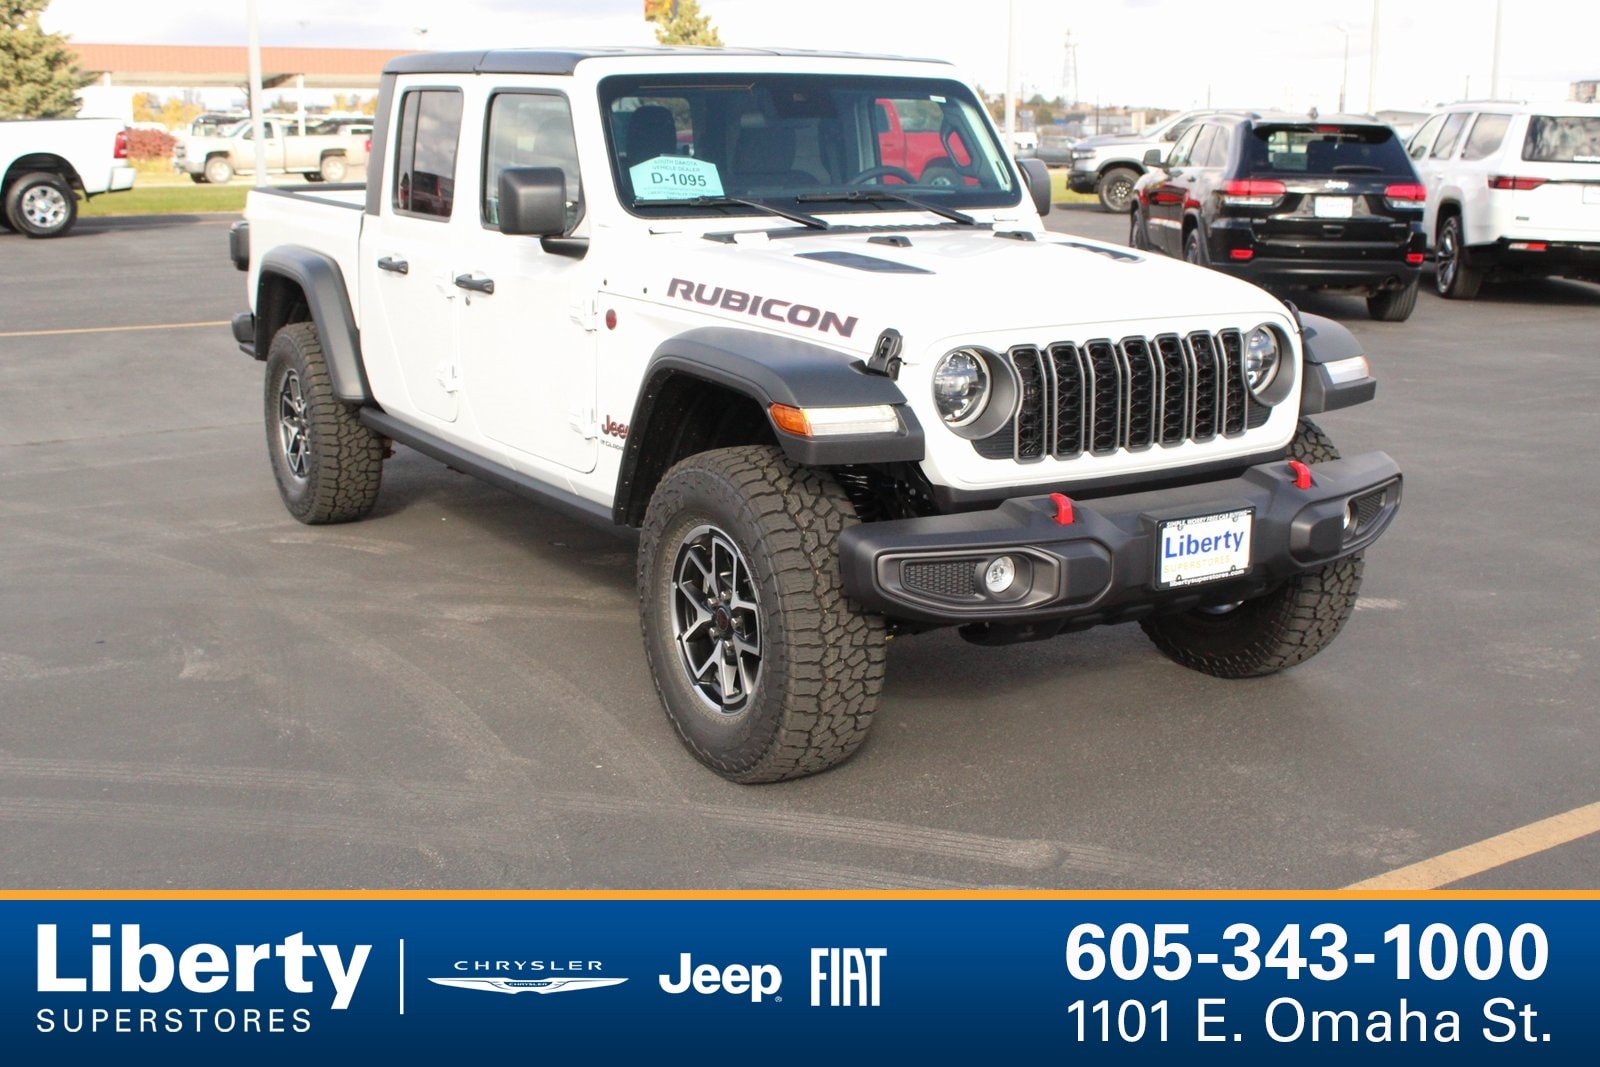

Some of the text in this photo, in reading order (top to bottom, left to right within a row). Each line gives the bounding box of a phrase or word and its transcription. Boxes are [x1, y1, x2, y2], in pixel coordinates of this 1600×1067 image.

[651, 172, 707, 187] D-1095
[667, 278, 859, 338] RUBICON
[1165, 531, 1244, 558] Liberty
[1164, 555, 1231, 574] SUPERSTORES
